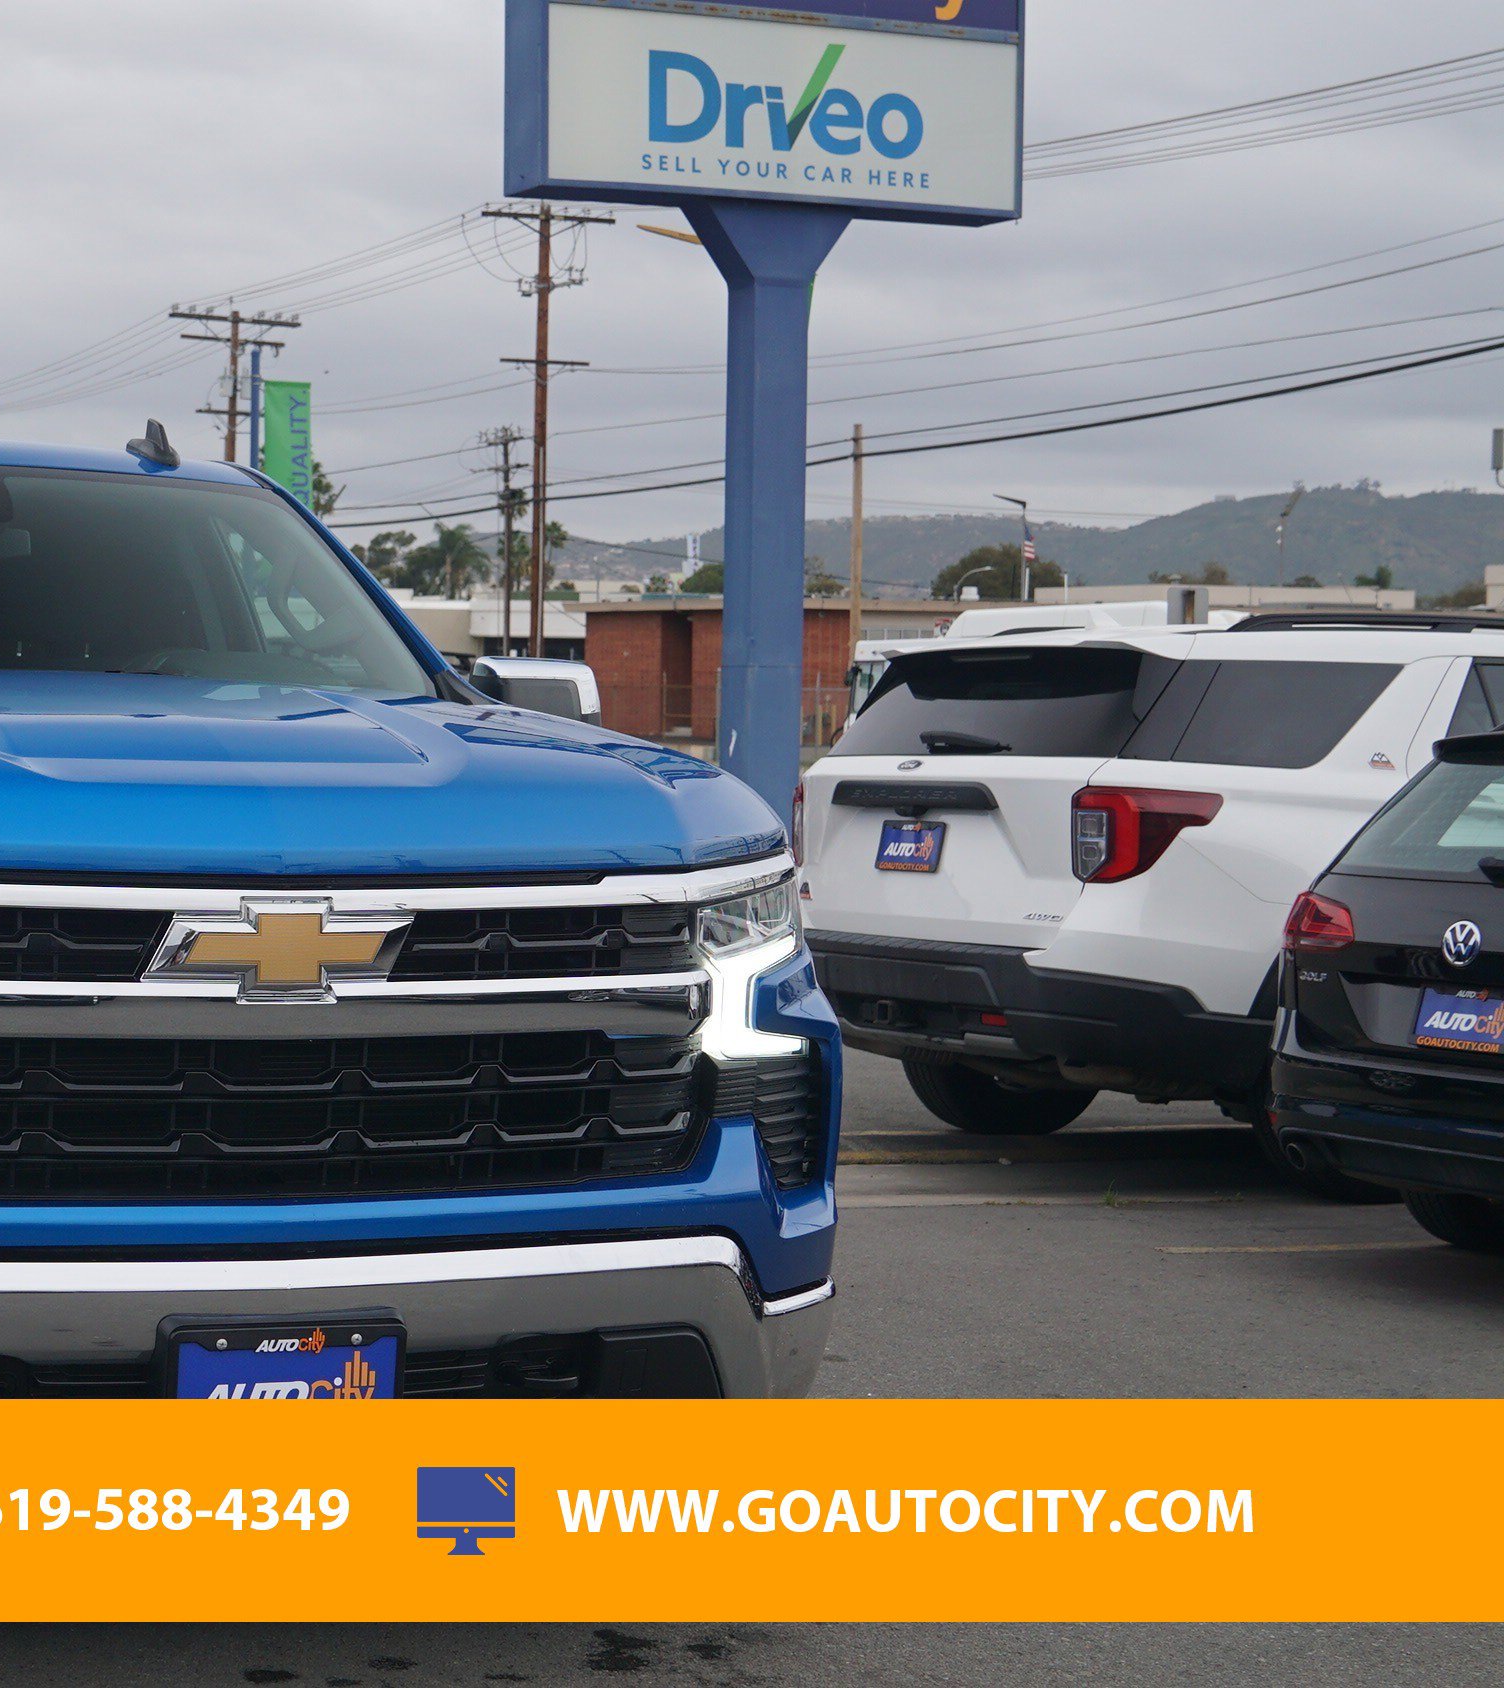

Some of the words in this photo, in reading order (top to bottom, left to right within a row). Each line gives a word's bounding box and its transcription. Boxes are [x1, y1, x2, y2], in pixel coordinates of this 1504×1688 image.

[648, 43, 924, 160] Driveo
[641, 153, 702, 174] SELL
[718, 157, 788, 180] YOUR
[803, 164, 853, 184] CAR
[868, 169, 931, 189] HERE
[878, 861, 930, 872] GOAUTOCITY.COM
[1416, 1035, 1500, 1053] GOAUTOCITY.COM
